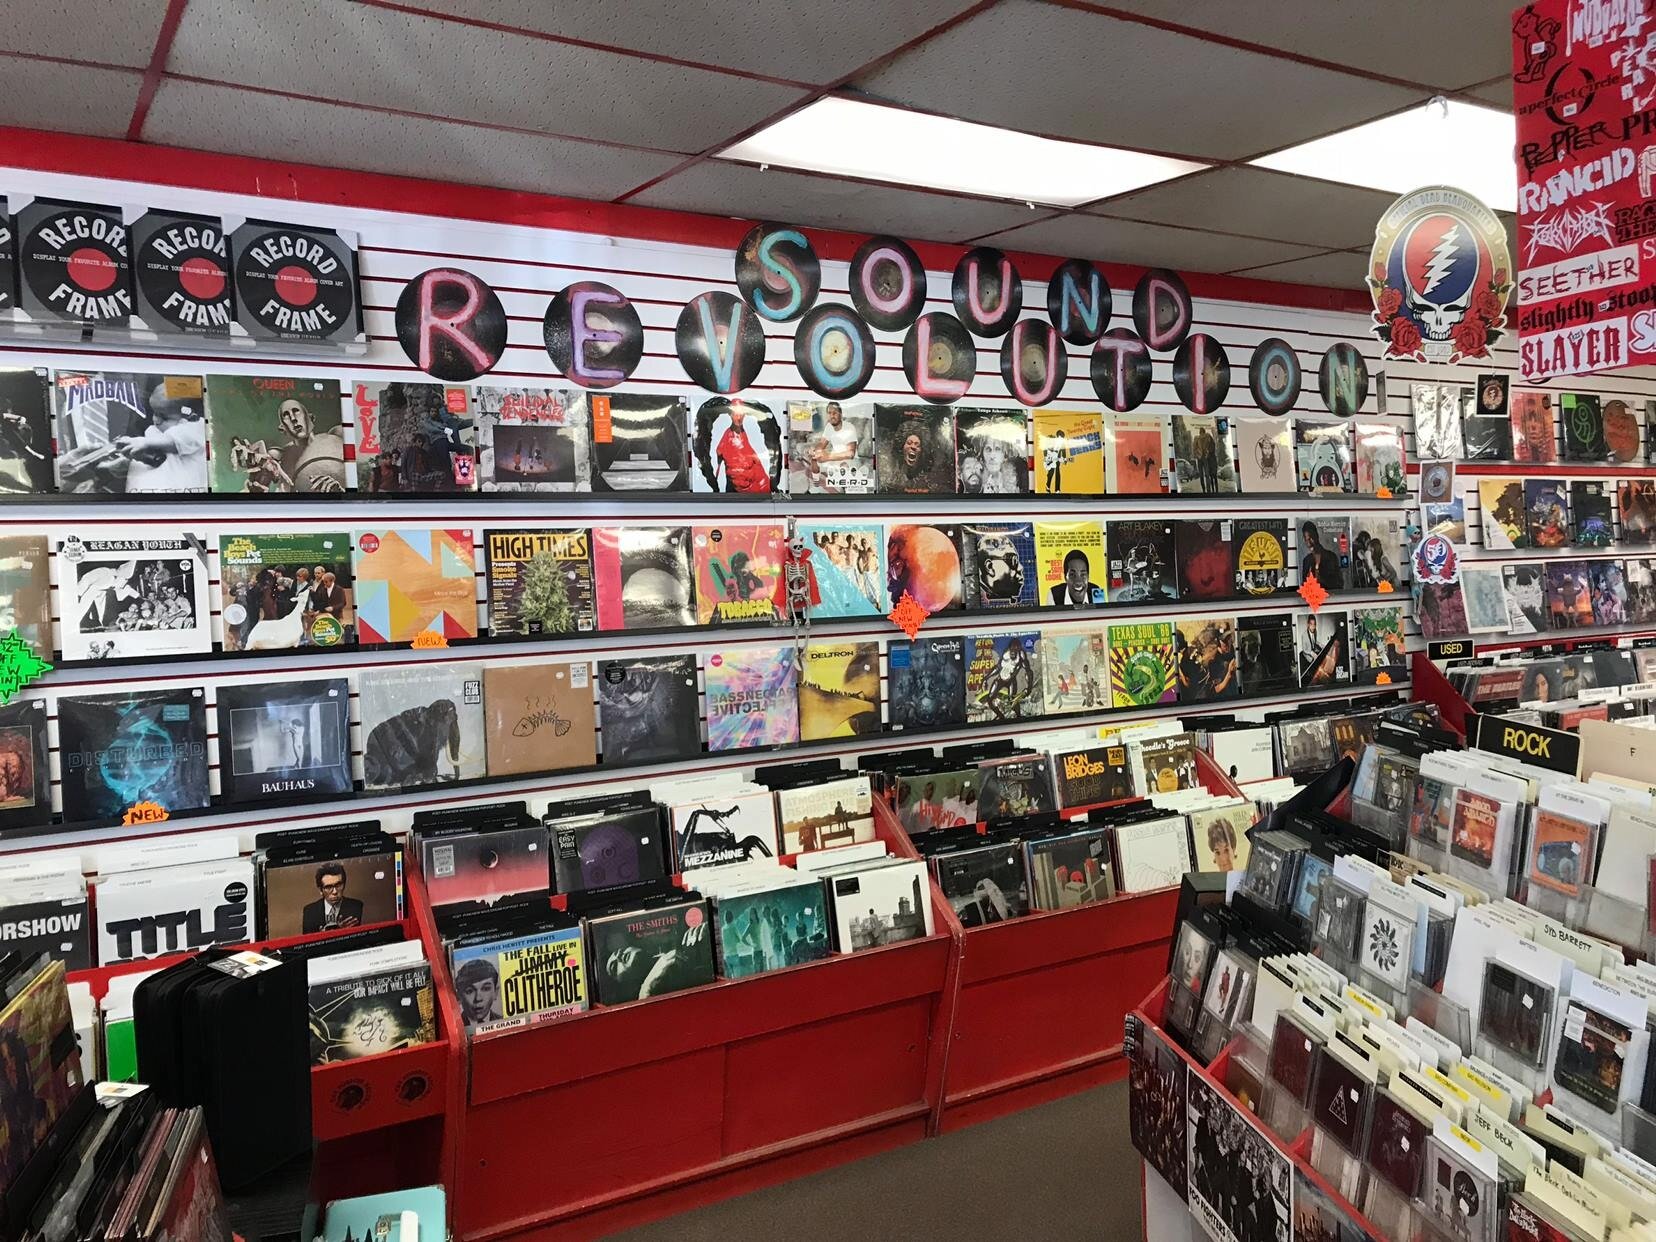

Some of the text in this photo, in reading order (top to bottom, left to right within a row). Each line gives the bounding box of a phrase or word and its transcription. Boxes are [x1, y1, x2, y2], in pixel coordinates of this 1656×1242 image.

[1519, 147, 1635, 215] RANCID
[152, 226, 227, 259] RECOR
[250, 236, 337, 274] RECORD
[1518, 255, 1639, 301] SEETHER
[752, 229, 1186, 348] SOUND
[260, 300, 336, 332] FRAME
[1520, 296, 1595, 332] slightly
[418, 270, 1357, 414] REVOLUTION
[1520, 325, 1621, 378] SLAYER
[252, 377, 295, 391] QUEEN
[65, 379, 147, 419] MADBALL
[89, 540, 139, 550] REAGAN
[228, 543, 256, 551] Beach
[231, 537, 252, 545] The
[492, 534, 588, 560] HIGH TIMES
[1249, 536, 1275, 552] SUN
[223, 550, 246, 558] Boys
[246, 549, 262, 558] Pet
[717, 600, 773, 619] TOBACCO
[1112, 625, 1136, 641] TEXAS
[1138, 624, 1156, 639] SOUL
[811, 650, 854, 660] DELTRON
[1440, 642, 1463, 655] USED
[970, 660, 996, 670] SUPER
[465, 681, 479, 689] FUZZ
[968, 674, 984, 684] APE
[465, 688, 479, 696] CLUB
[1166, 738, 1190, 750] Groove
[1503, 727, 1552, 758] ROCK
[68, 741, 205, 769] DISTURBED
[1063, 753, 1088, 767] LEON
[1630, 747, 1636, 757] F
[1064, 762, 1105, 780] BRIDGES
[261, 779, 315, 793] BAUHAUS
[130, 808, 165, 824] NEW
[560, 841, 575, 849] PAIN
[684, 848, 744, 866] MEZZANINE
[106, 901, 248, 959] TITLE
[627, 915, 678, 931] THE SMITHS
[483, 935, 556, 953] CHRIS HEWITT PRESENTS
[1544, 924, 1592, 952] SYD BARRETT
[504, 941, 577, 961] THE FALL LIVE IN
[511, 950, 569, 978] JIMMY
[326, 987, 333, 995] A
[333, 981, 364, 994] TRIBUTE
[365, 979, 375, 987] TO
[376, 976, 393, 986] SICK
[394, 975, 404, 983] OF
[413, 971, 426, 979] ALL
[353, 976, 426, 998] OUR IMPACT WILL BE FELT
[503, 965, 582, 1018] CLITHEROE
[538, 1007, 574, 1019] THURSDAY
[481, 1019, 521, 1033] THE GRAND
[1474, 1113, 1514, 1151] JEFF BECK
[1189, 1185, 1226, 1237] FOO FIGHTERS
